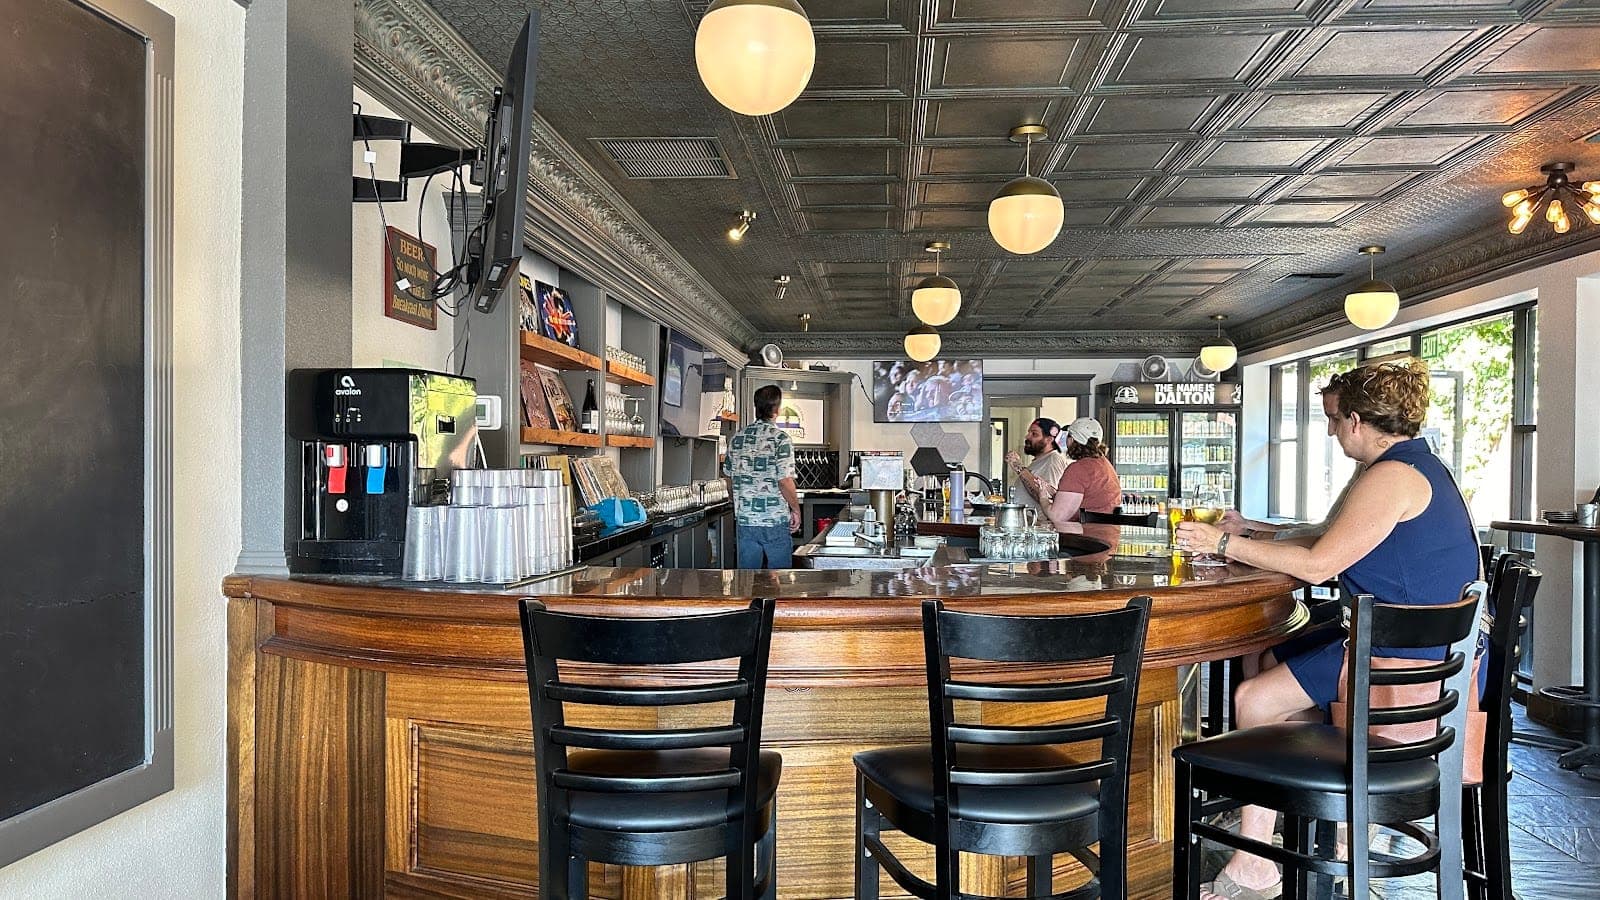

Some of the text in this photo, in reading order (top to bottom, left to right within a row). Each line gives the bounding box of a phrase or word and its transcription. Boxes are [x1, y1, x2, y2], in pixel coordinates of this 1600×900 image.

[1423, 337, 1437, 357] EXIT
[335, 387, 361, 395] avalon
[1154, 383, 1215, 392] THE NAME IS
[1154, 391, 1215, 405] DALTON
